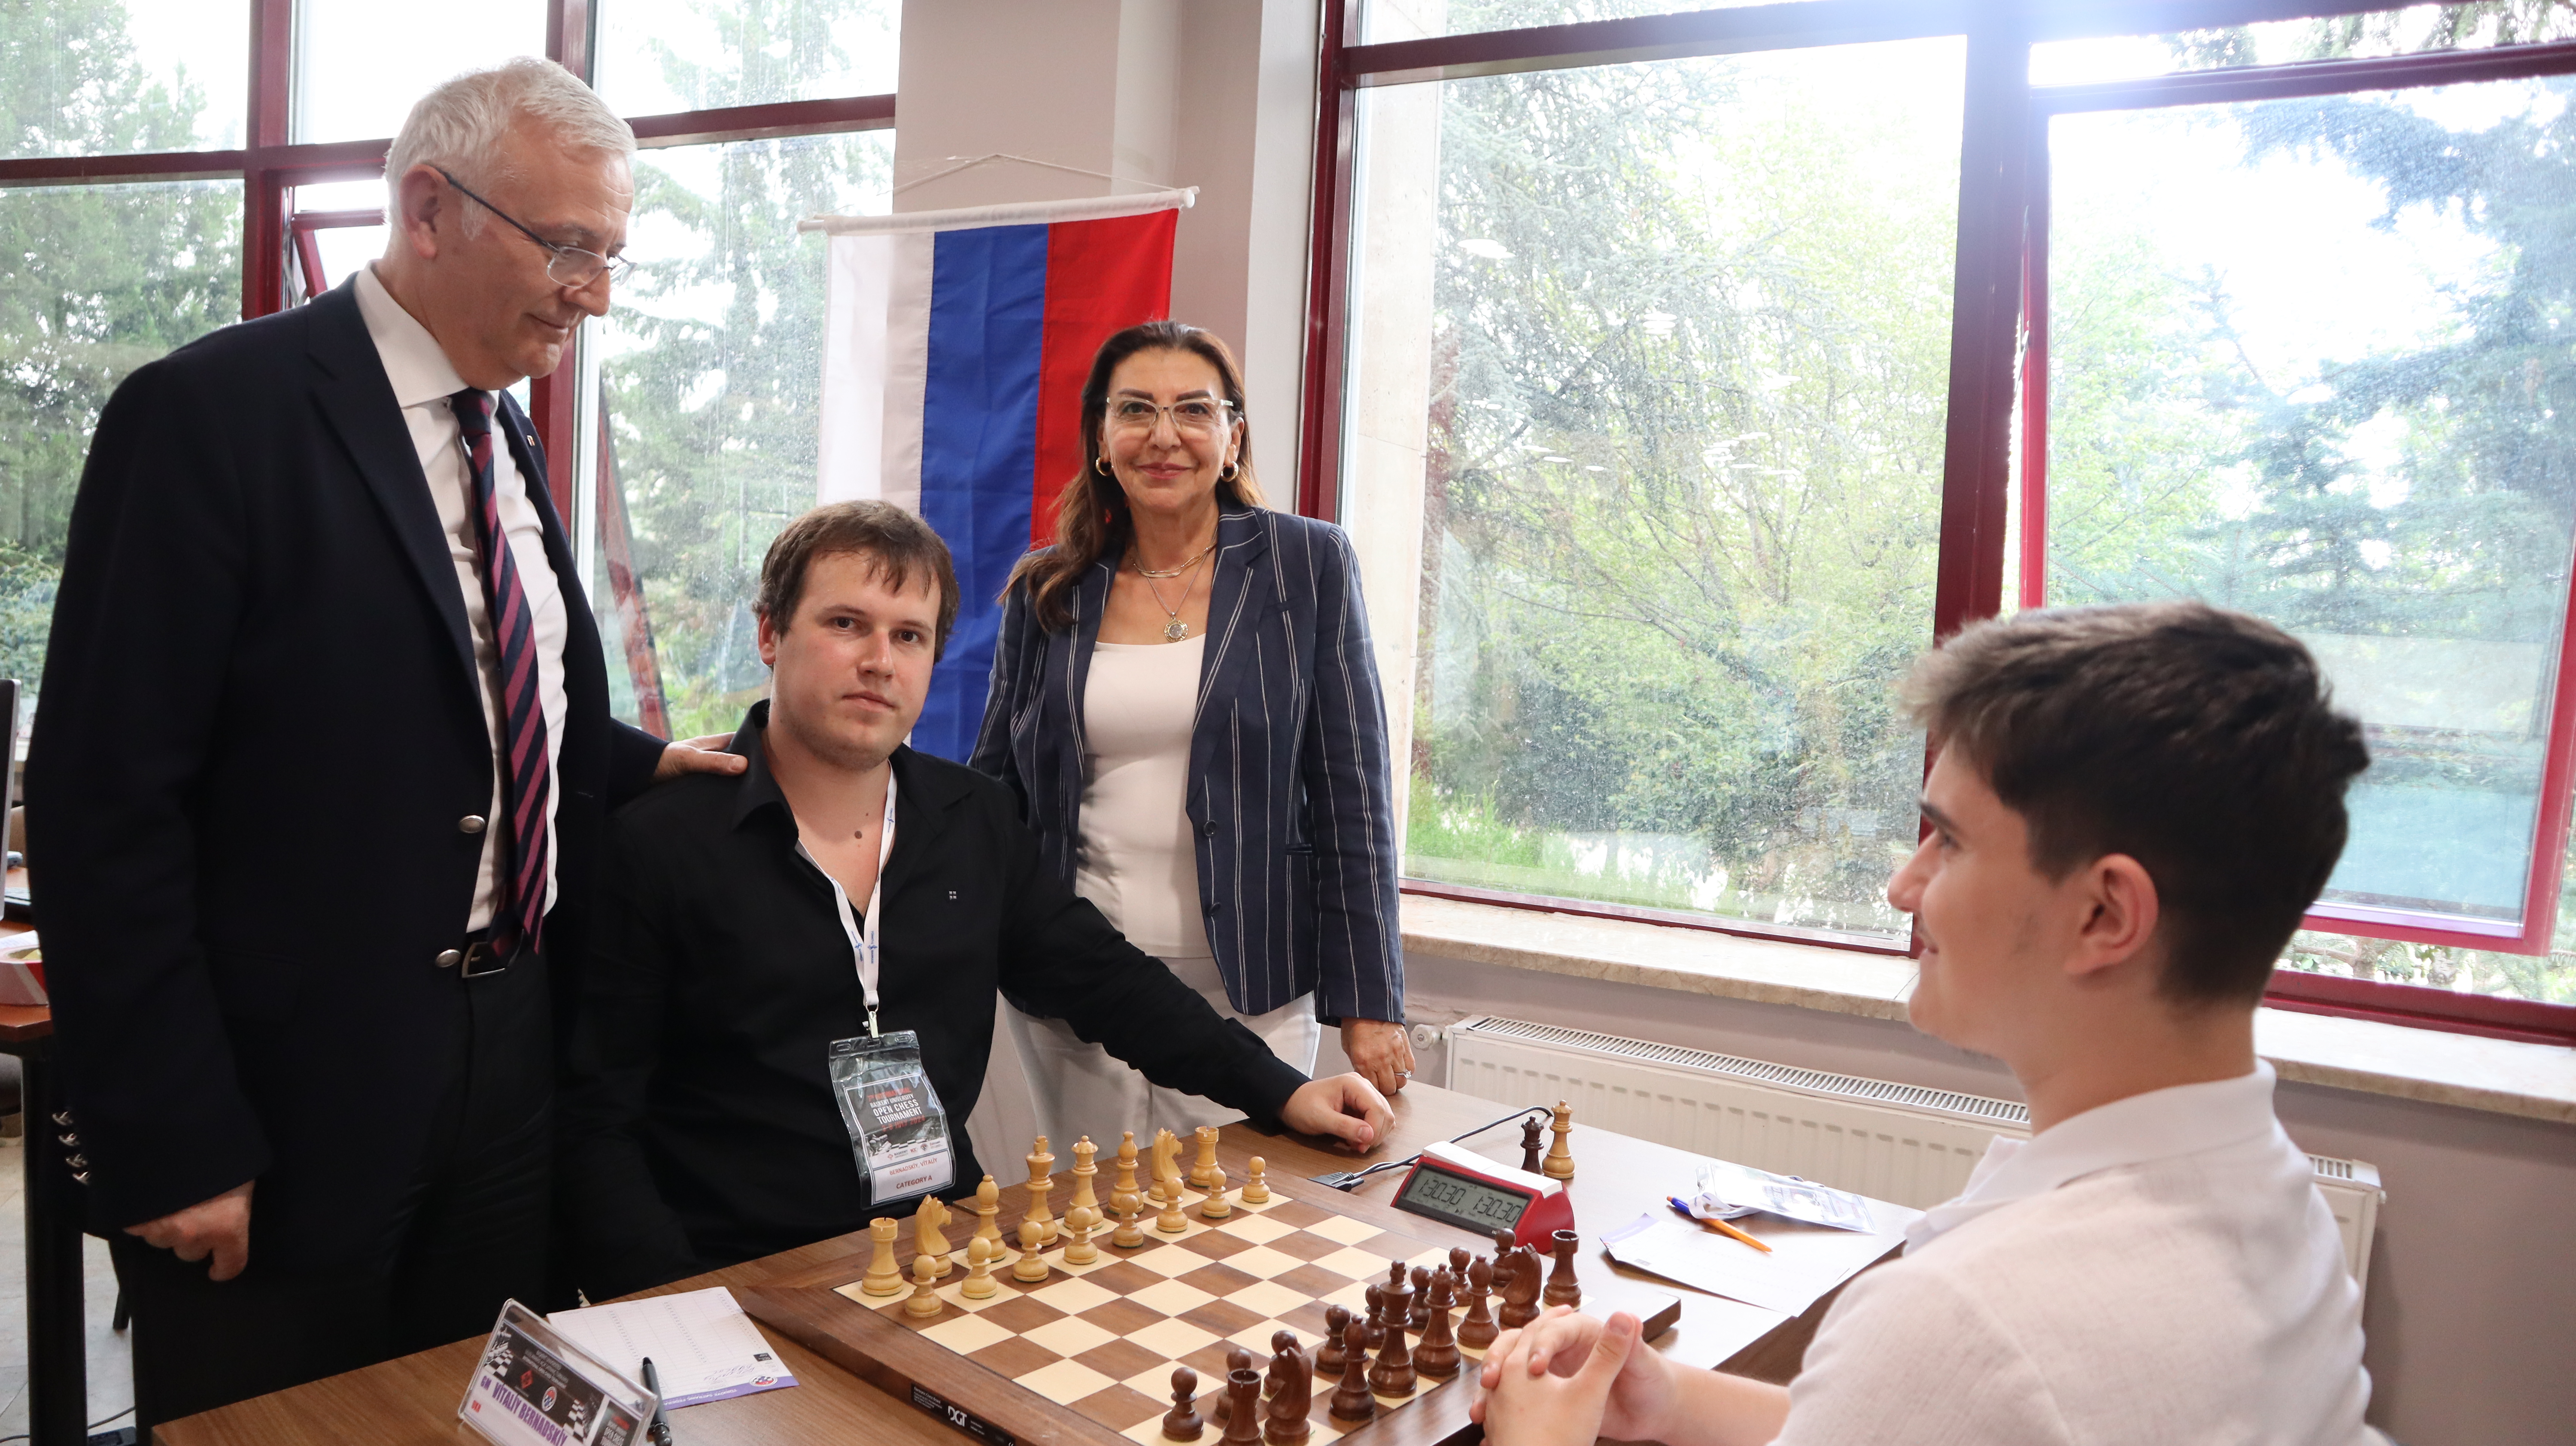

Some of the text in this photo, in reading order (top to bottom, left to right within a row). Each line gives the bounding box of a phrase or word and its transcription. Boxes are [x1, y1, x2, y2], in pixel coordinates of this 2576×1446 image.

[889, 1093, 914, 1103] UNIVERSITY
[873, 1099, 919, 1117] OPEN CHESS
[877, 1106, 922, 1124] TOURNAMENT
[890, 1157, 937, 1176] BERNADSKİY, VİTALİY
[896, 1176, 927, 1189] CATEGORY
[480, 1375, 492, 1391] GM
[492, 1382, 522, 1414] VİTALİY
[518, 1402, 568, 1446] BERNADSKİY
[948, 1405, 967, 1427] DGT
